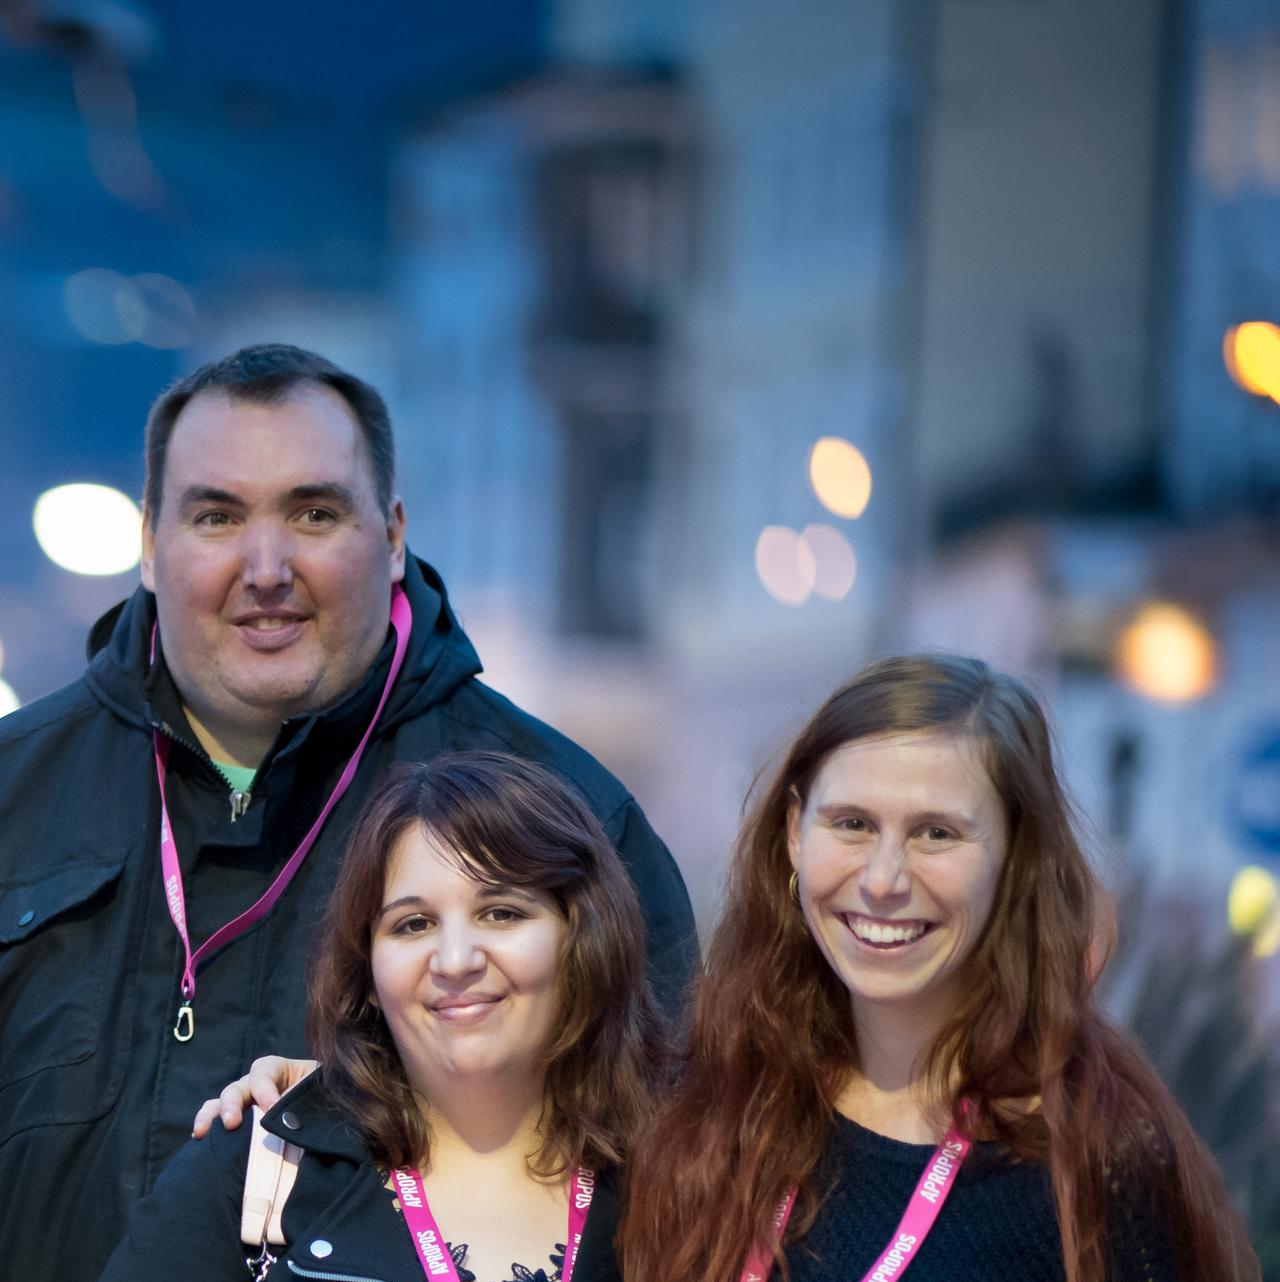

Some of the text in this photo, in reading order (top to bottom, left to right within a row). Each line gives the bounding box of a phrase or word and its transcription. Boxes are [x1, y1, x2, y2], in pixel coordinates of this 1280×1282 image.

[575, 1166, 594, 1209] ROPOS
[920, 1140, 963, 1203] APROPOS
[417, 1229, 449, 1275] APROPOS
